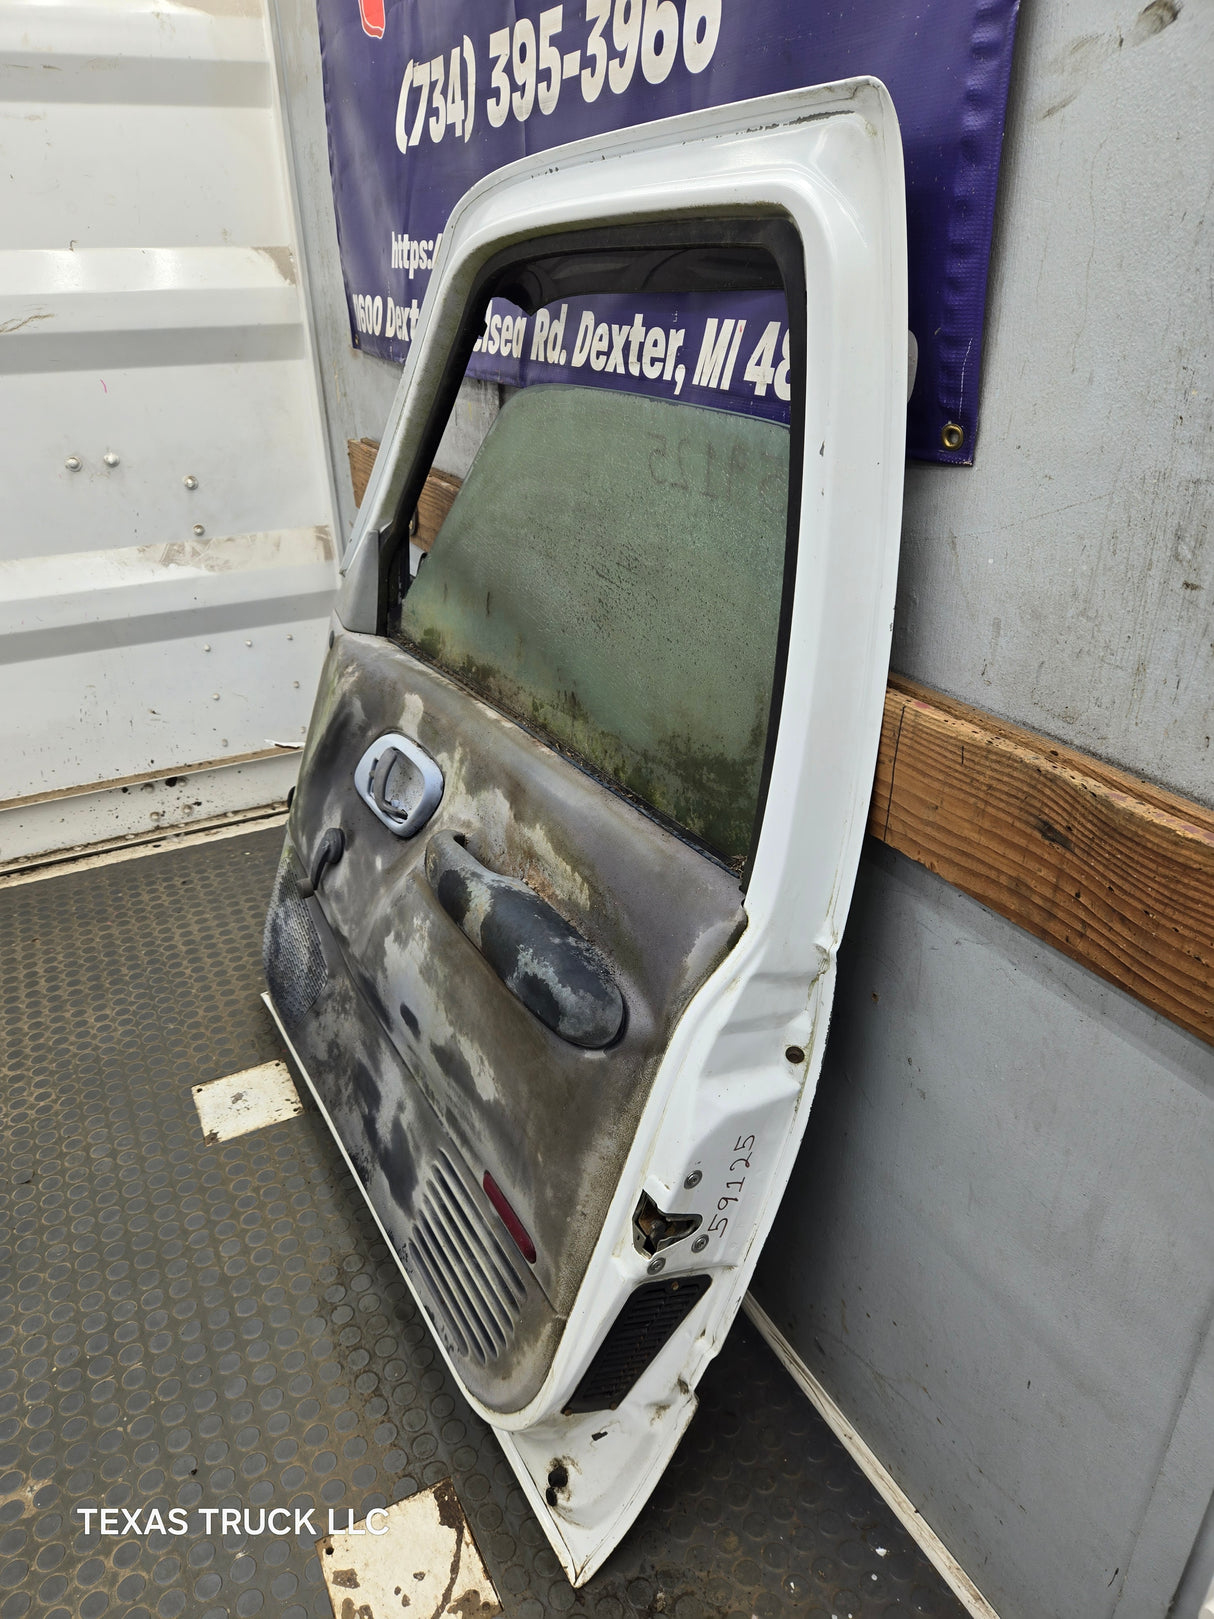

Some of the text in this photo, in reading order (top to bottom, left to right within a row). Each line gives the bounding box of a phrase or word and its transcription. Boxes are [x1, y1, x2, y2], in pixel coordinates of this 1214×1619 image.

[395, 34, 476, 155] (734)
[473, 300, 527, 358] lsea
[530, 303, 568, 365] Rd.
[571, 310, 686, 395] Dexter,
[692, 318, 747, 391] MI
[707, 1134, 755, 1238] 59125
